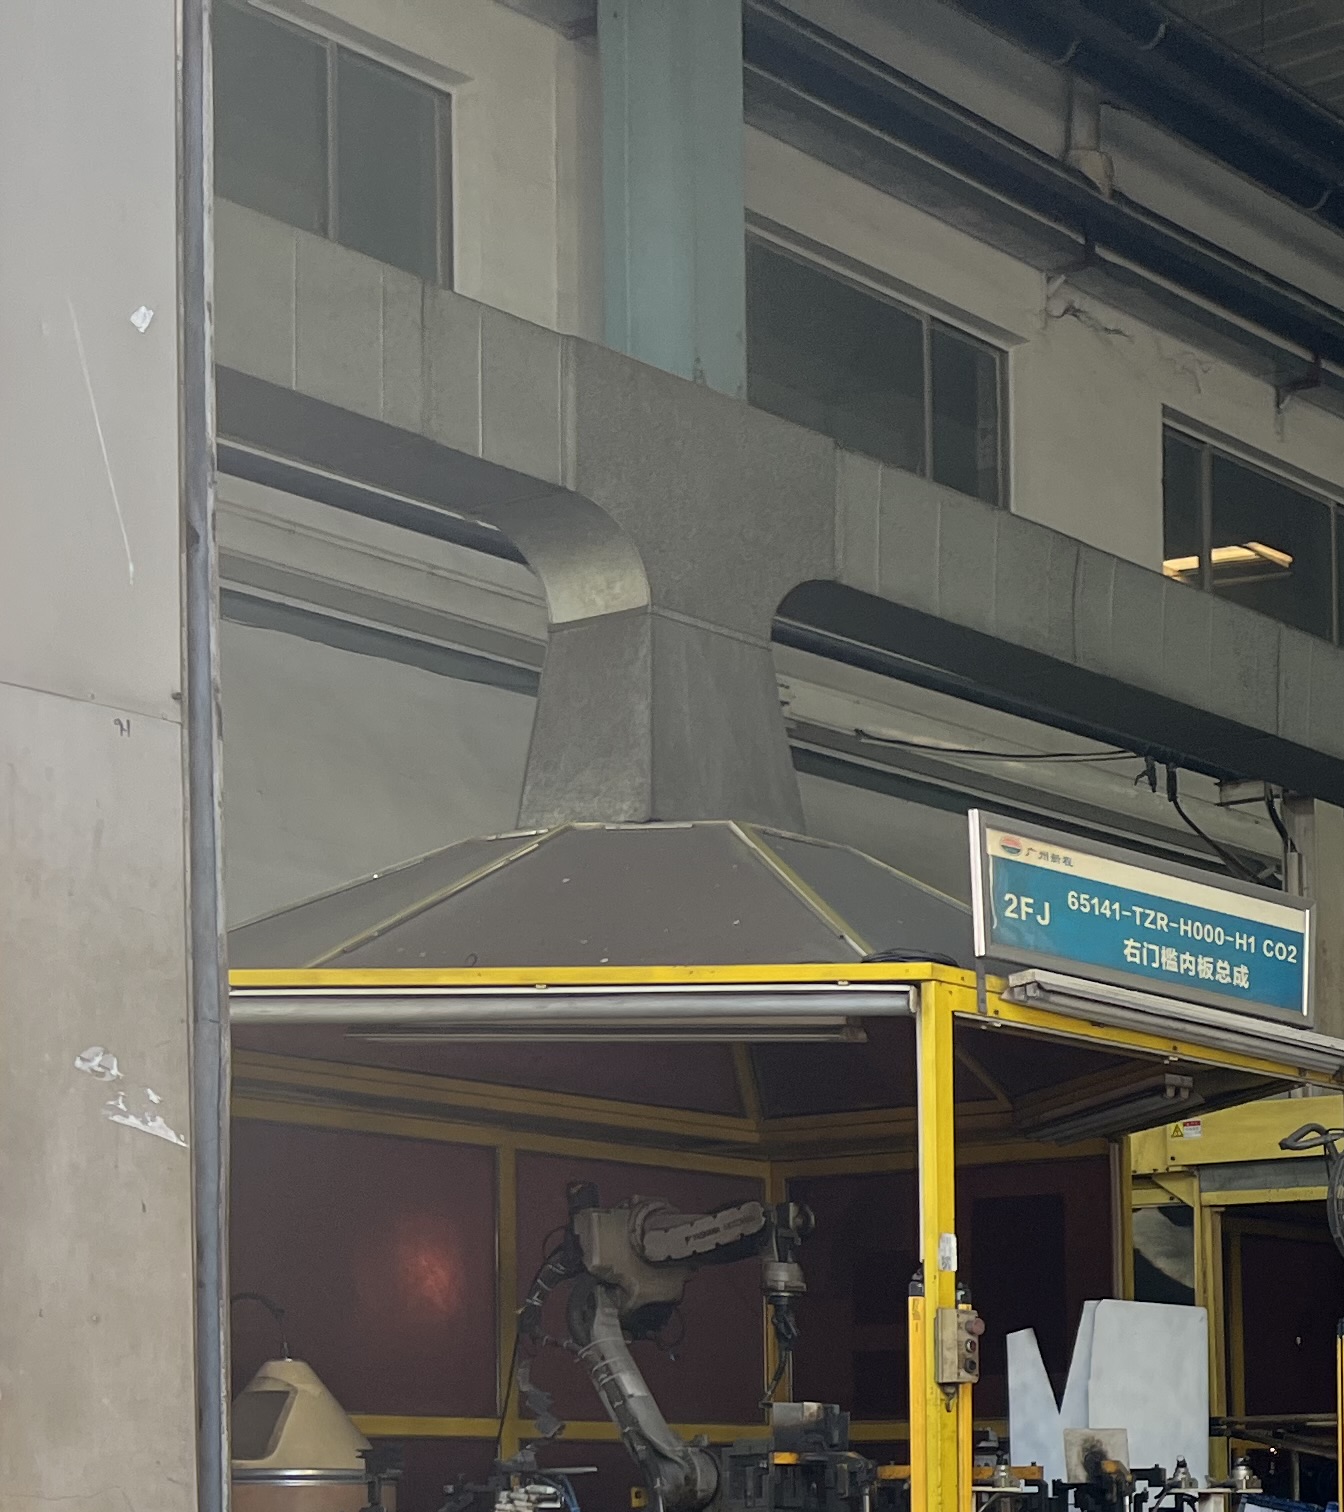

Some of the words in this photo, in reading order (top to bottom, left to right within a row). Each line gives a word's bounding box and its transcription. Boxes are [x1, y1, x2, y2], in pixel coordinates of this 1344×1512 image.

[1003, 893, 1051, 926] 2FJ
[1067, 891, 1256, 954] 65141-TZR-H000-H1
[1123, 938, 1250, 989] 右门槛内板总成
